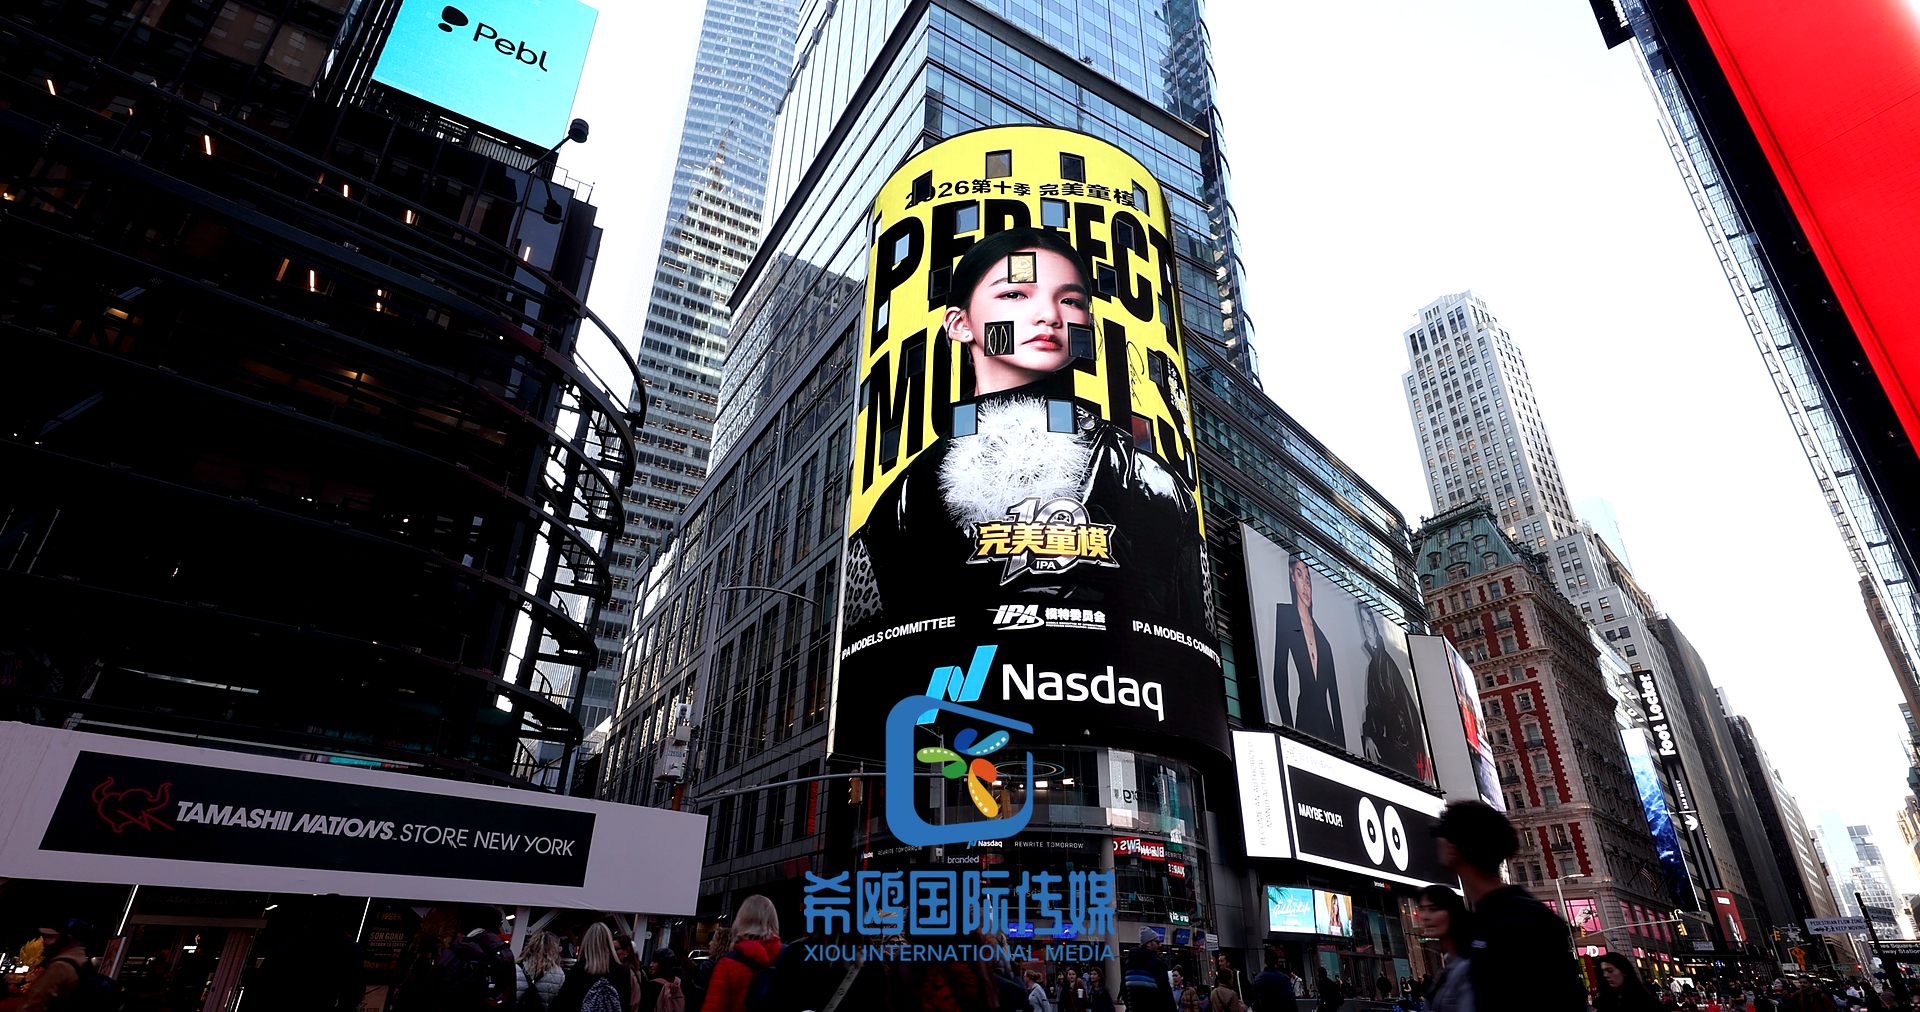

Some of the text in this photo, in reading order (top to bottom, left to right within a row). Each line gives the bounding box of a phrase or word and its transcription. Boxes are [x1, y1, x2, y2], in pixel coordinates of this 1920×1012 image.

[473, 22, 548, 72] Pebl
[977, 523, 1109, 559] 完美童模
[1035, 560, 1056, 570] IPA
[992, 604, 1040, 625] IPA
[851, 631, 884, 655] MODELS
[884, 616, 956, 640] COMMITTEE
[1132, 620, 1152, 634] IPA
[1153, 624, 1193, 647] MODELS
[1002, 663, 1165, 722] Nasdaq
[1639, 673, 1677, 756] Foot Locker
[1298, 802, 1324, 822] MAYBE
[176, 801, 293, 831] TAMASHII
[400, 823, 469, 849] STORE
[473, 830, 521, 851] NEW
[524, 835, 576, 856] YORK
[978, 840, 1003, 848] Nasdaq
[947, 855, 980, 864] branded
